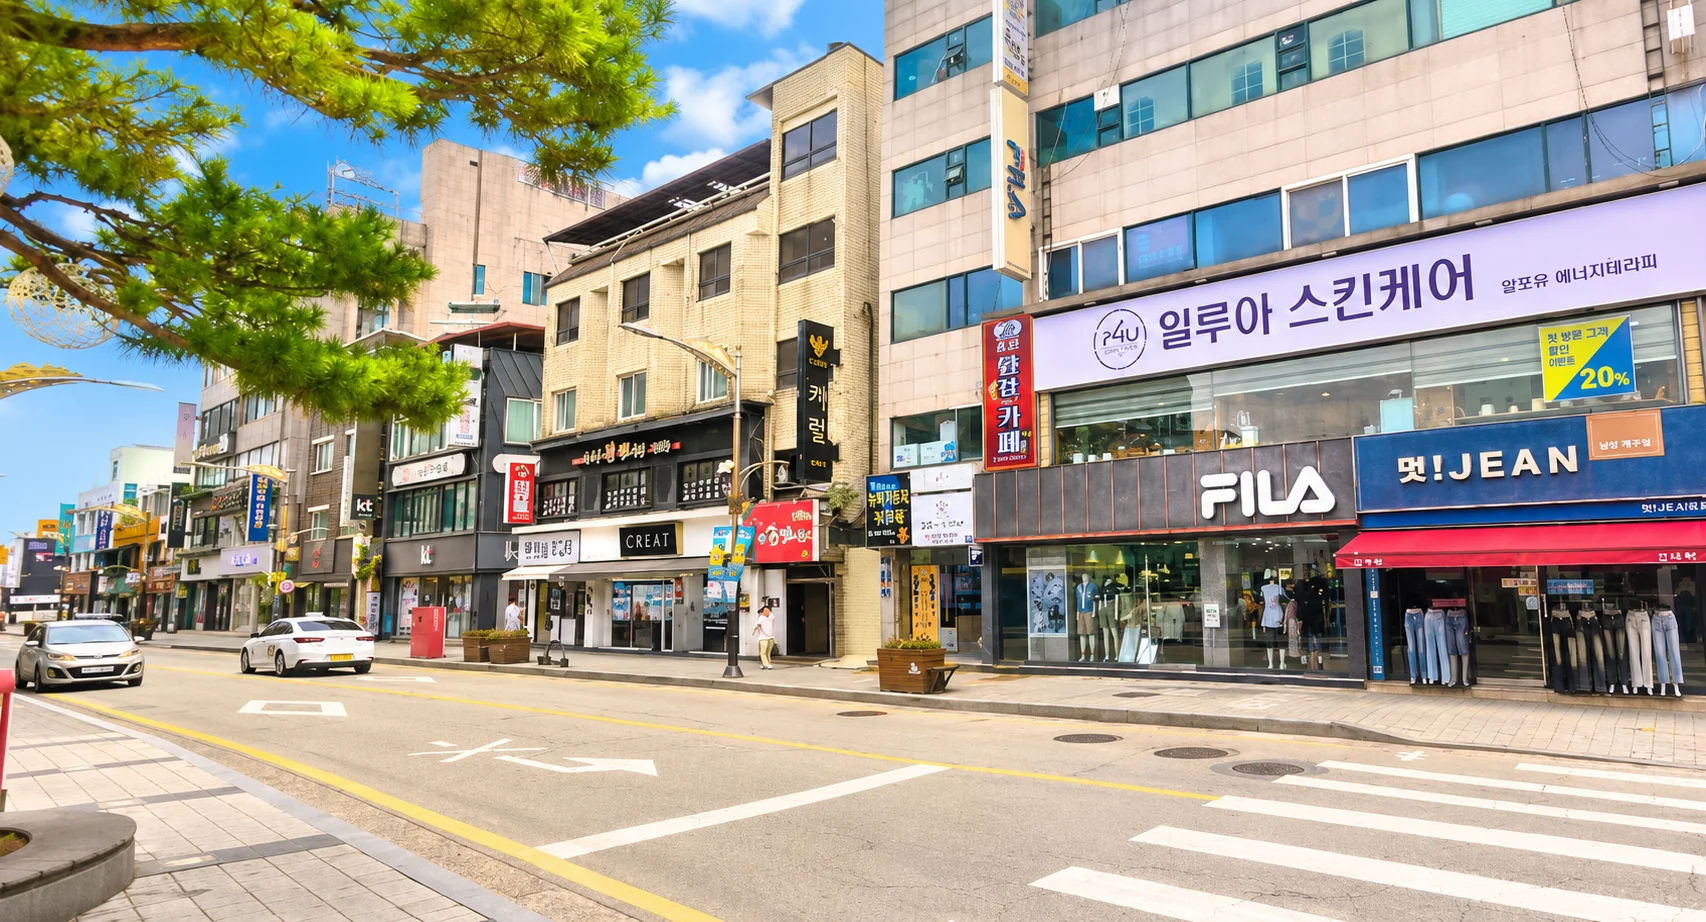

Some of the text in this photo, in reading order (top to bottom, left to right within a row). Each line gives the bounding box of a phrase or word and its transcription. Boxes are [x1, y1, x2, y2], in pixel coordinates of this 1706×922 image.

[1501, 253, 1657, 294] 알포유 에너지테라피
[1159, 253, 1474, 350] 일루아 스킨케어
[1579, 366, 1630, 390] 20%
[1397, 445, 1578, 484] 멋!JEAN
[356, 498, 373, 512] kt
[1200, 465, 1336, 520] FILA
[420, 545, 433, 565] kt
[625, 532, 669, 549] CREAT
